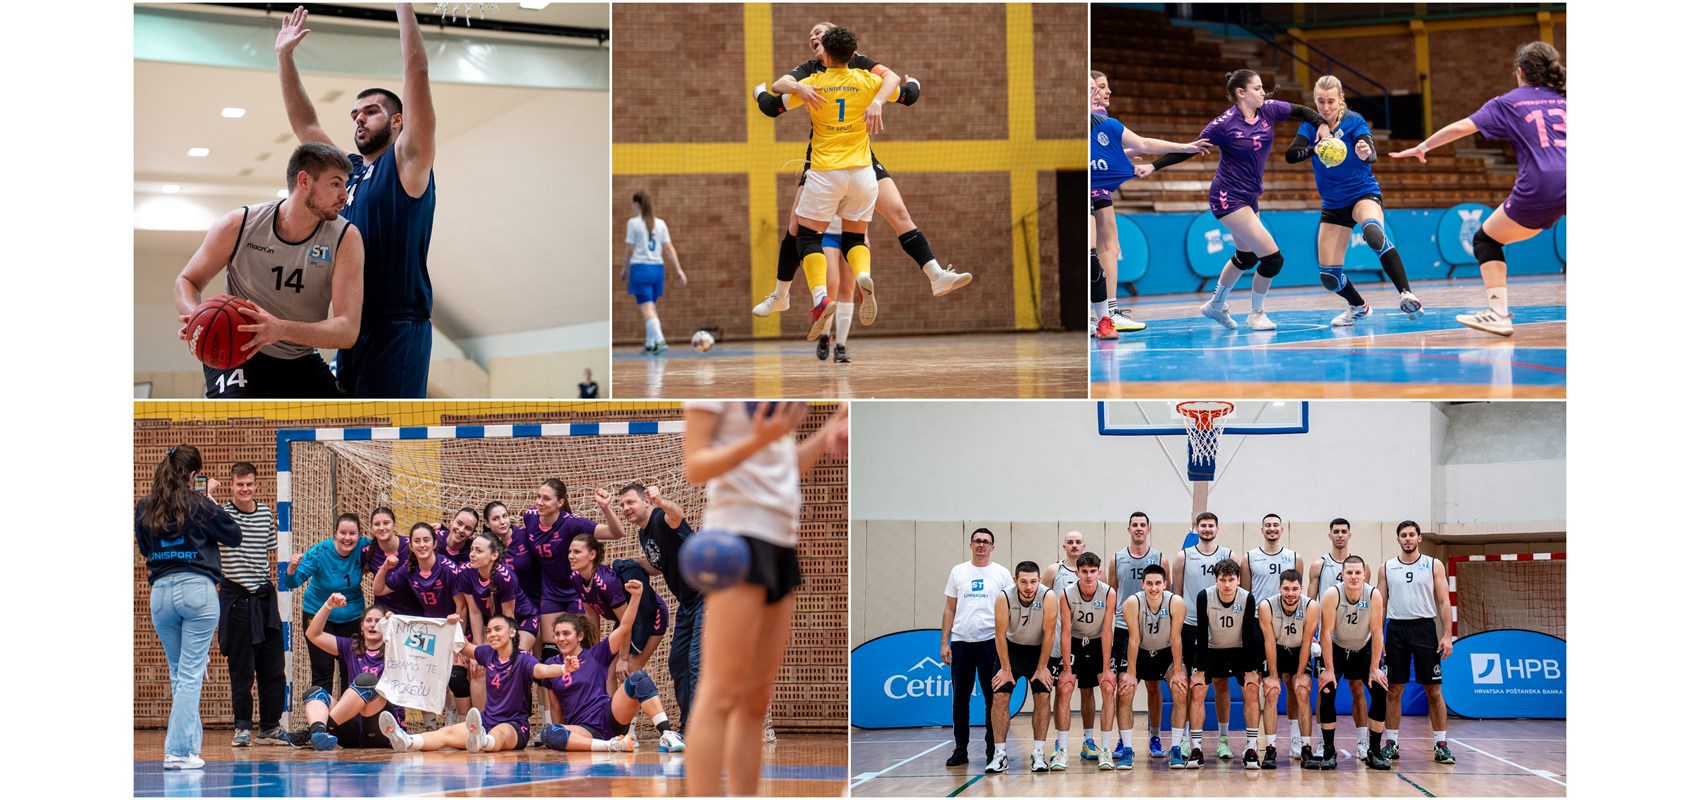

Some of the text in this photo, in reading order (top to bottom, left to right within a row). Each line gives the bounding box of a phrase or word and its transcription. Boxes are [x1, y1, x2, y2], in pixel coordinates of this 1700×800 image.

[823, 85, 860, 93] UNIVERSITY
[835, 98, 846, 123] 1
[836, 124, 853, 132] SPLIT
[1252, 135, 1262, 151] 5
[246, 242, 275, 255] macron
[311, 244, 329, 260] ST
[271, 265, 305, 294] 14
[215, 368, 248, 394] 14
[535, 543, 553, 558] 15
[1130, 567, 1144, 580] 15
[1200, 563, 1214, 577] 14
[343, 573, 351, 588] 1
[1405, 571, 1414, 584] 9
[420, 591, 437, 606] 13
[1021, 615, 1029, 627] 7
[1077, 610, 1094, 624] 20
[1219, 616, 1234, 628] 10
[1346, 612, 1358, 625] 12
[396, 622, 429, 634] NIKA
[1284, 622, 1297, 636] 16
[409, 633, 434, 651] ST
[426, 663, 440, 674] TE
[1505, 658, 1561, 679] HPB
[491, 673, 501, 689] 4
[561, 672, 573, 687] 9
[1505, 687, 1541, 695] POŠTANSKA
